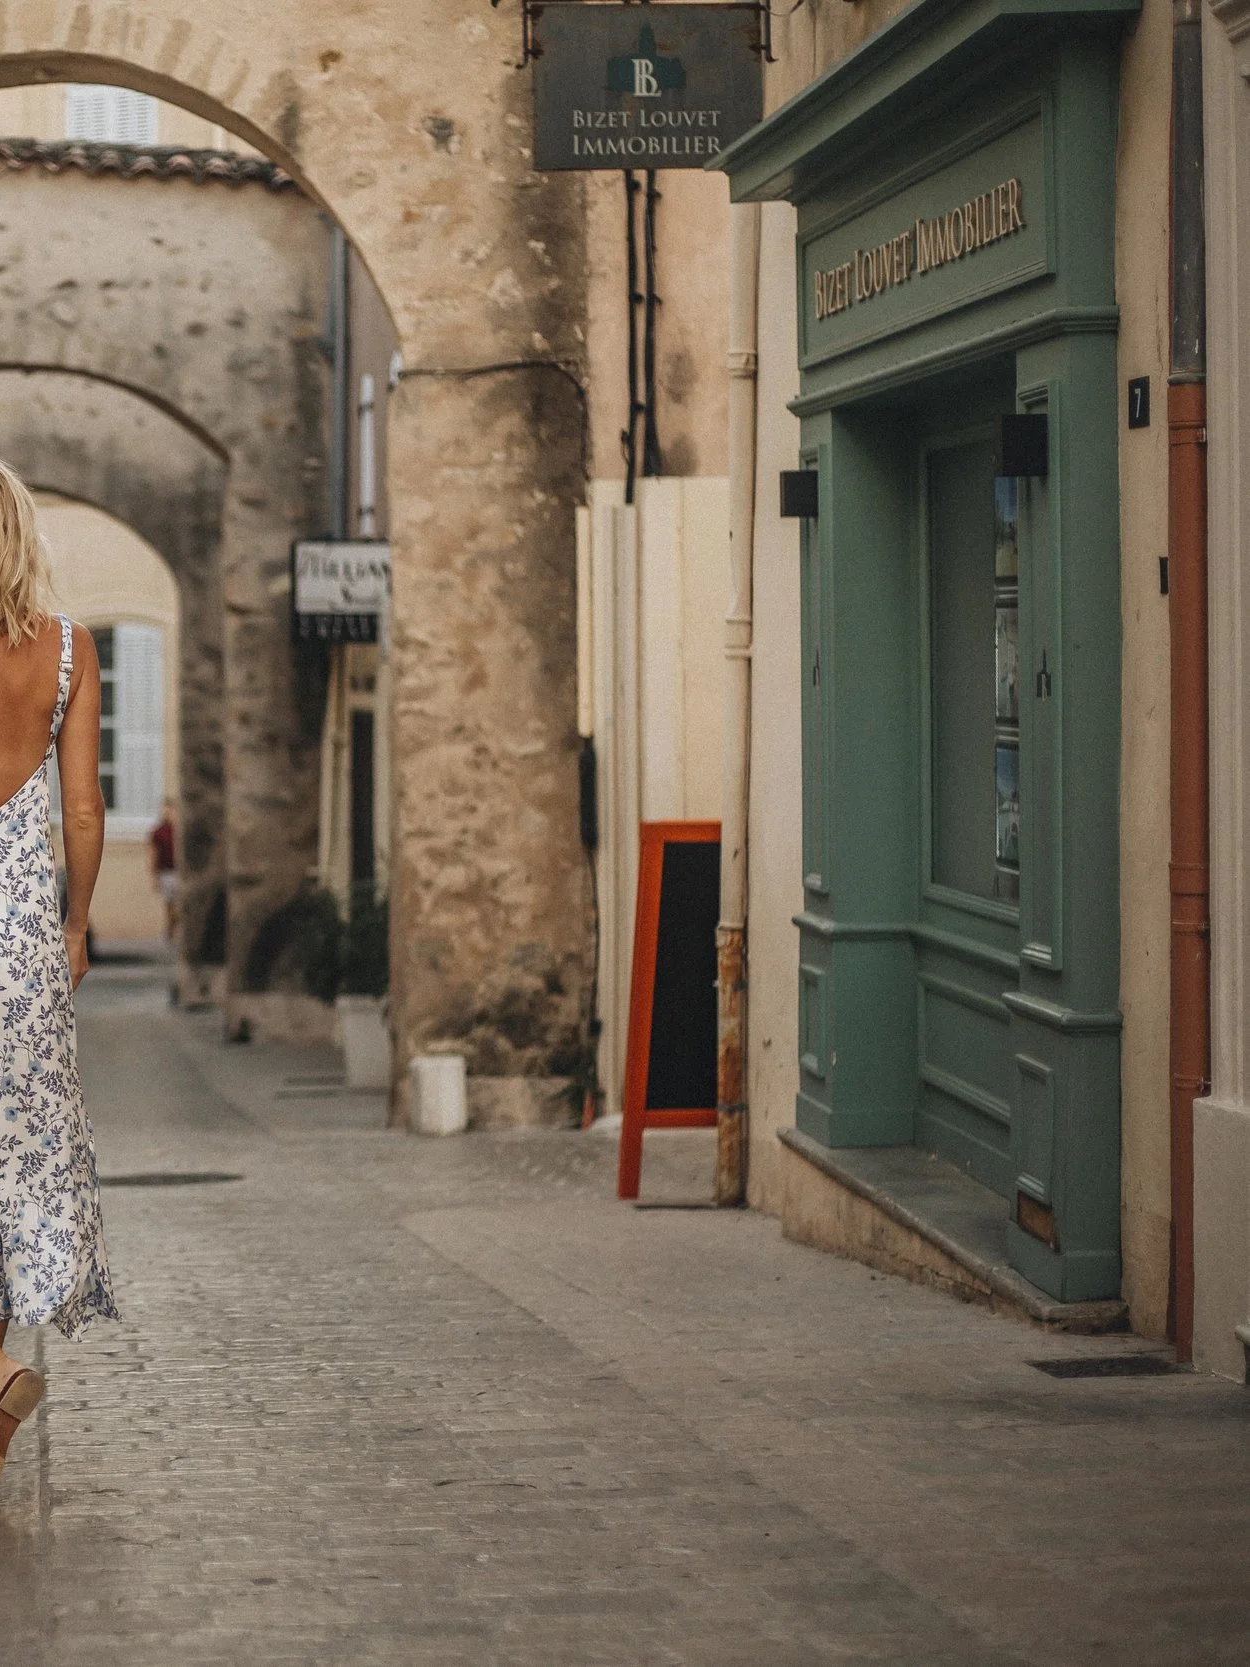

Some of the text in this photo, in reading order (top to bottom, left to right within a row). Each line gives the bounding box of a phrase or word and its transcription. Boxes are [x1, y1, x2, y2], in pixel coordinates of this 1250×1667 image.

[572, 109, 721, 128] BIZET LOUVET
[573, 135, 722, 155] IMMOBILIER
[814, 178, 1025, 320] BIZET LOUVET IMMOBILIER
[1134, 388, 1142, 418] 7
